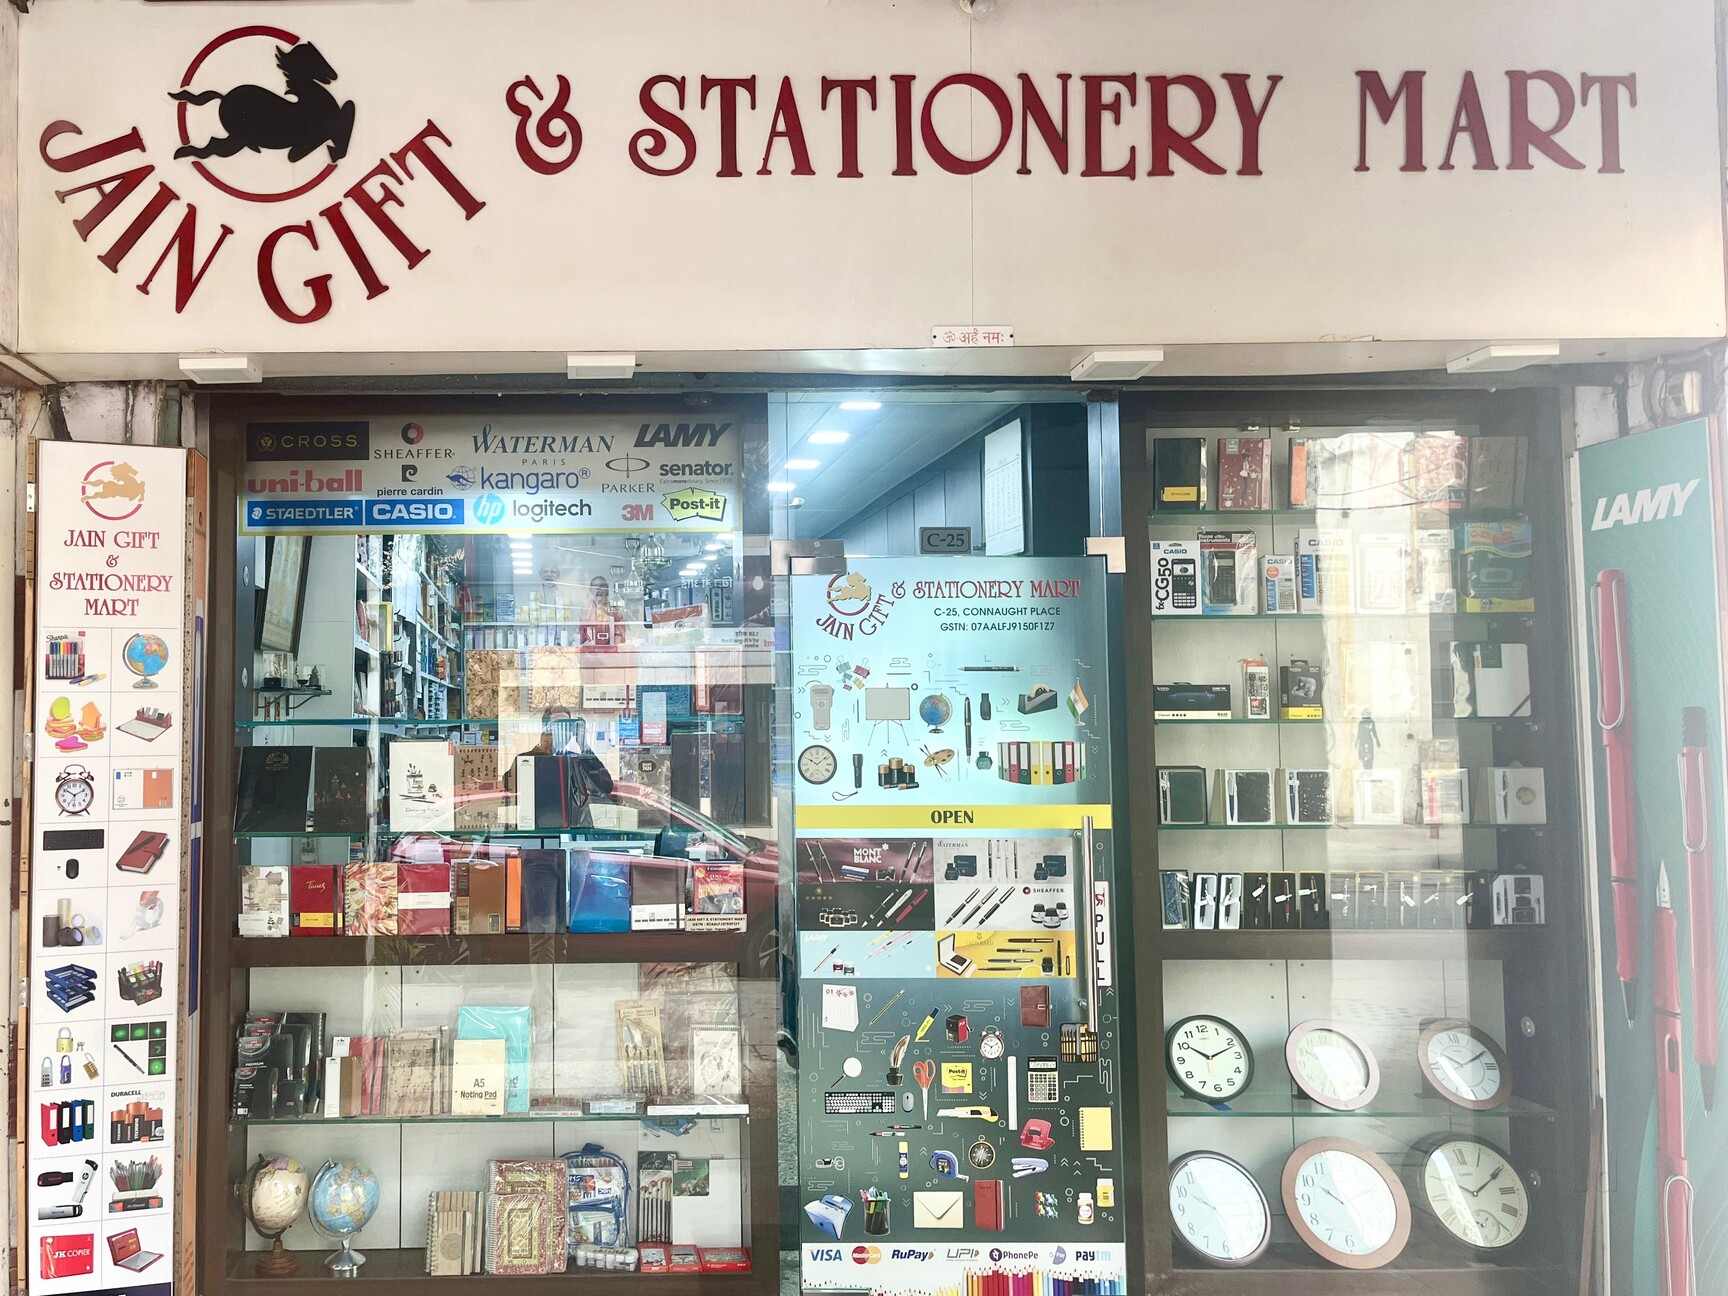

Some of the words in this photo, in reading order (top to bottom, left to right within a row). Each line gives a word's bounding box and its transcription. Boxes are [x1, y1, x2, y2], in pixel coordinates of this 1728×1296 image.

[38, 119, 235, 314] JAIN
[256, 119, 486, 325] GIFT
[505, 74, 582, 175] &
[628, 73, 1284, 180] STATIONERY
[1353, 69, 1638, 174] MART
[281, 434, 359, 448] CROSS
[471, 423, 615, 454] WATERMAN
[633, 423, 733, 448] LAMY
[374, 448, 453, 460] SHEAFFER
[521, 458, 566, 466] PARIS
[659, 460, 732, 477] senator
[247, 469, 363, 494] uni-ball
[601, 482, 655, 494] PARKER
[376, 487, 407, 498] pierre
[410, 486, 443, 497] cardin
[478, 494, 501, 522] hp
[669, 497, 720, 510] Post-it
[1590, 478, 1701, 531] LAMY
[266, 507, 354, 520] STAEDTLER
[372, 503, 453, 520] CASIO
[513, 498, 592, 523] logitech
[621, 504, 654, 521] 3M
[64, 529, 106, 548] JAIN
[114, 531, 160, 549] GIFT
[927, 533, 964, 547] C-25
[106, 555, 119, 567] &
[49, 572, 173, 592] STATIONERY
[84, 599, 139, 616] MART
[815, 613, 855, 641] JAIN
[859, 593, 895, 635] GIFT
[891, 580, 906, 599] &
[913, 580, 1024, 599] STATIONERY
[1030, 579, 1081, 598] MART
[934, 607, 960, 617] C-25,
[963, 607, 1027, 616] CONNAUGHT
[1030, 607, 1061, 616] PLACE
[940, 622, 968, 631] GSTN:
[930, 810, 974, 824] OPEN
[937, 840, 968, 848] WATERMAN
[853, 848, 882, 856] MONT
[853, 856, 882, 864] BLANC
[1096, 914, 1106, 980] PULL
[1184, 1031, 1193, 1039] 11
[1196, 1024, 1208, 1033] 12
[1214, 1028, 1219, 1036] 1
[1177, 1042, 1190, 1050] 10
[1226, 1038, 1235, 1046] 2
[1176, 1056, 1185, 1065] 9
[1234, 1052, 1242, 1060] 3
[1185, 1070, 1194, 1079] 8
[1233, 1066, 1242, 1074] 4
[473, 1078, 485, 1088] A5
[1198, 1080, 1206, 1089] 7
[1214, 1084, 1222, 1092] 6
[1226, 1078, 1235, 1086] 5
[460, 1091, 483, 1099] Noting
[484, 1090, 497, 1099] Pad
[1314, 1162, 1324, 1175] 11
[1302, 1174, 1315, 1188] 10
[1301, 1193, 1311, 1206] 9
[1309, 1212, 1319, 1226] 8
[1325, 1228, 1333, 1241] 7
[1345, 1234, 1355, 1248] 6
[53, 1251, 66, 1259] JK
[67, 1249, 91, 1257] COPIER
[810, 1249, 843, 1262] VISA
[891, 1249, 928, 1262] RuPay
[946, 1248, 975, 1259] UPI
[1003, 1250, 1039, 1260] PhonePe
